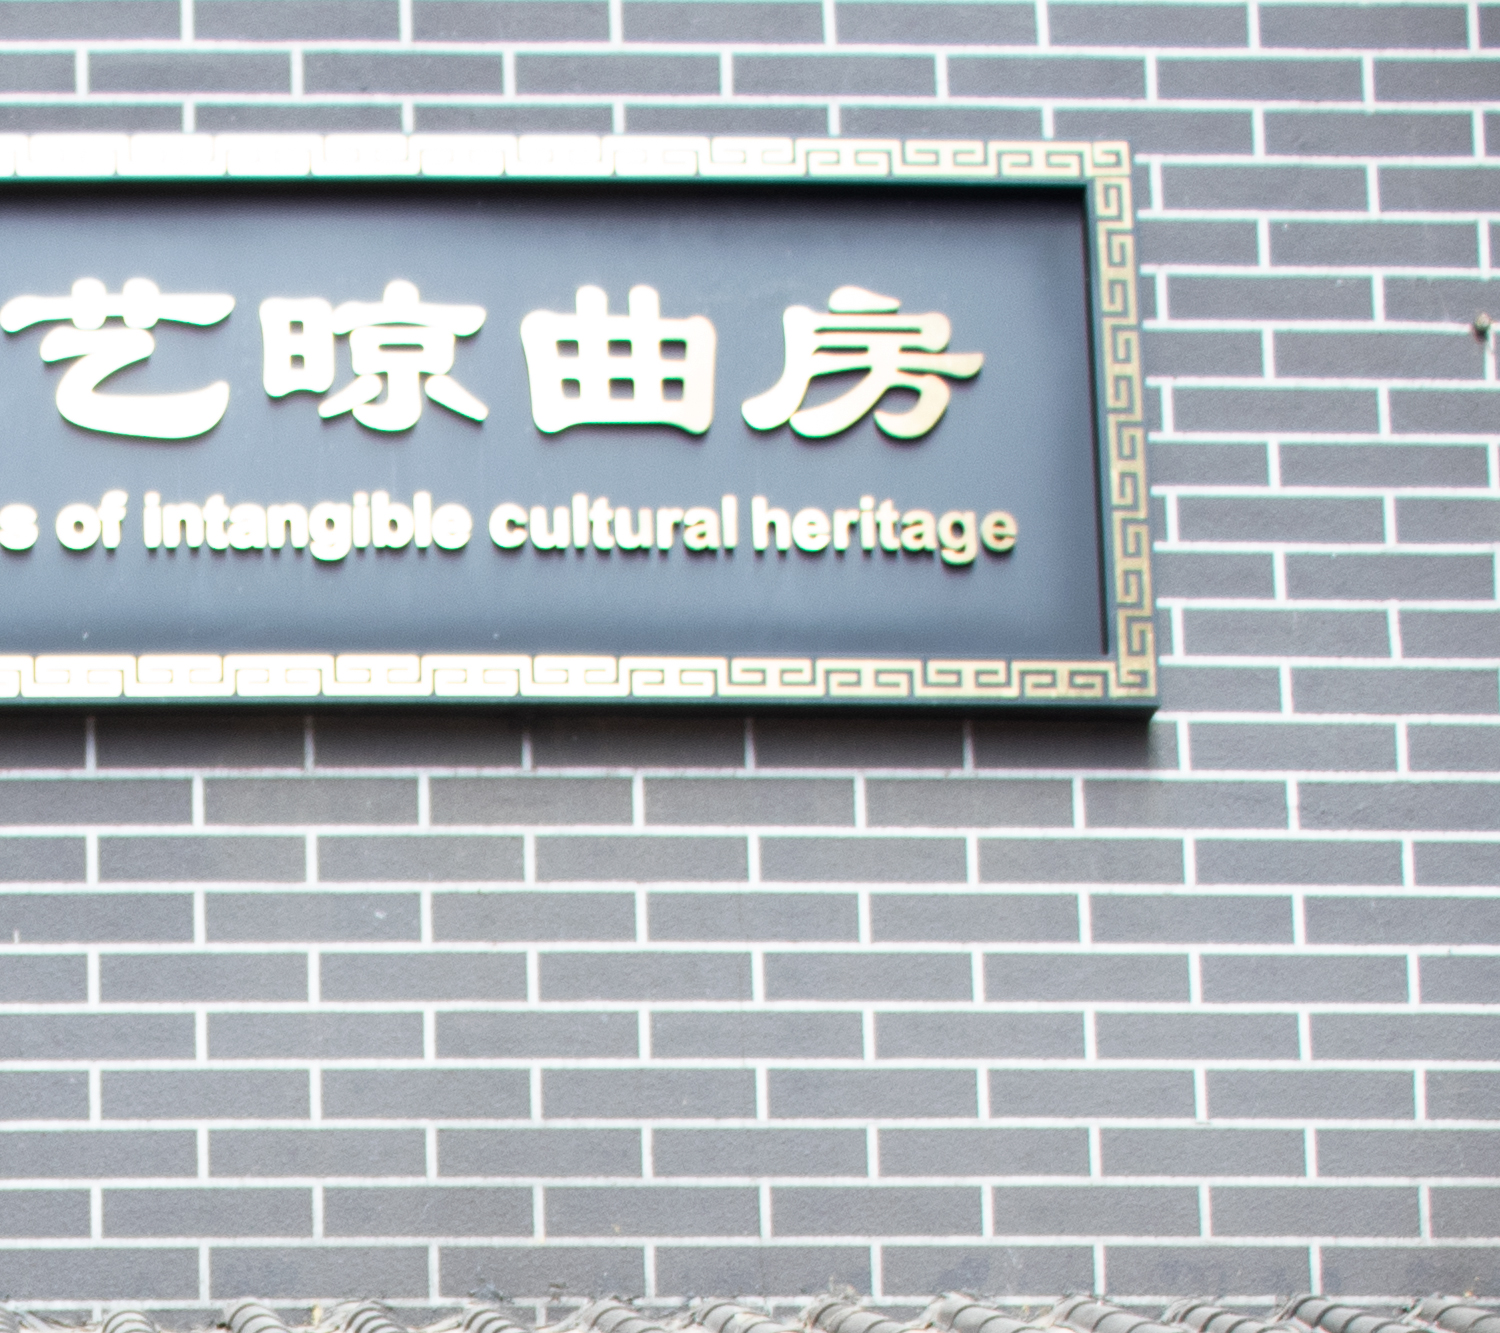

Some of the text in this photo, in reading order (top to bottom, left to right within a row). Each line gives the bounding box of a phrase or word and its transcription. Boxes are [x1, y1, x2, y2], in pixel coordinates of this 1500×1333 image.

[55, 488, 129, 549] of
[142, 489, 474, 560] intangible
[488, 493, 739, 550] cultural
[751, 494, 1019, 563] heritage
